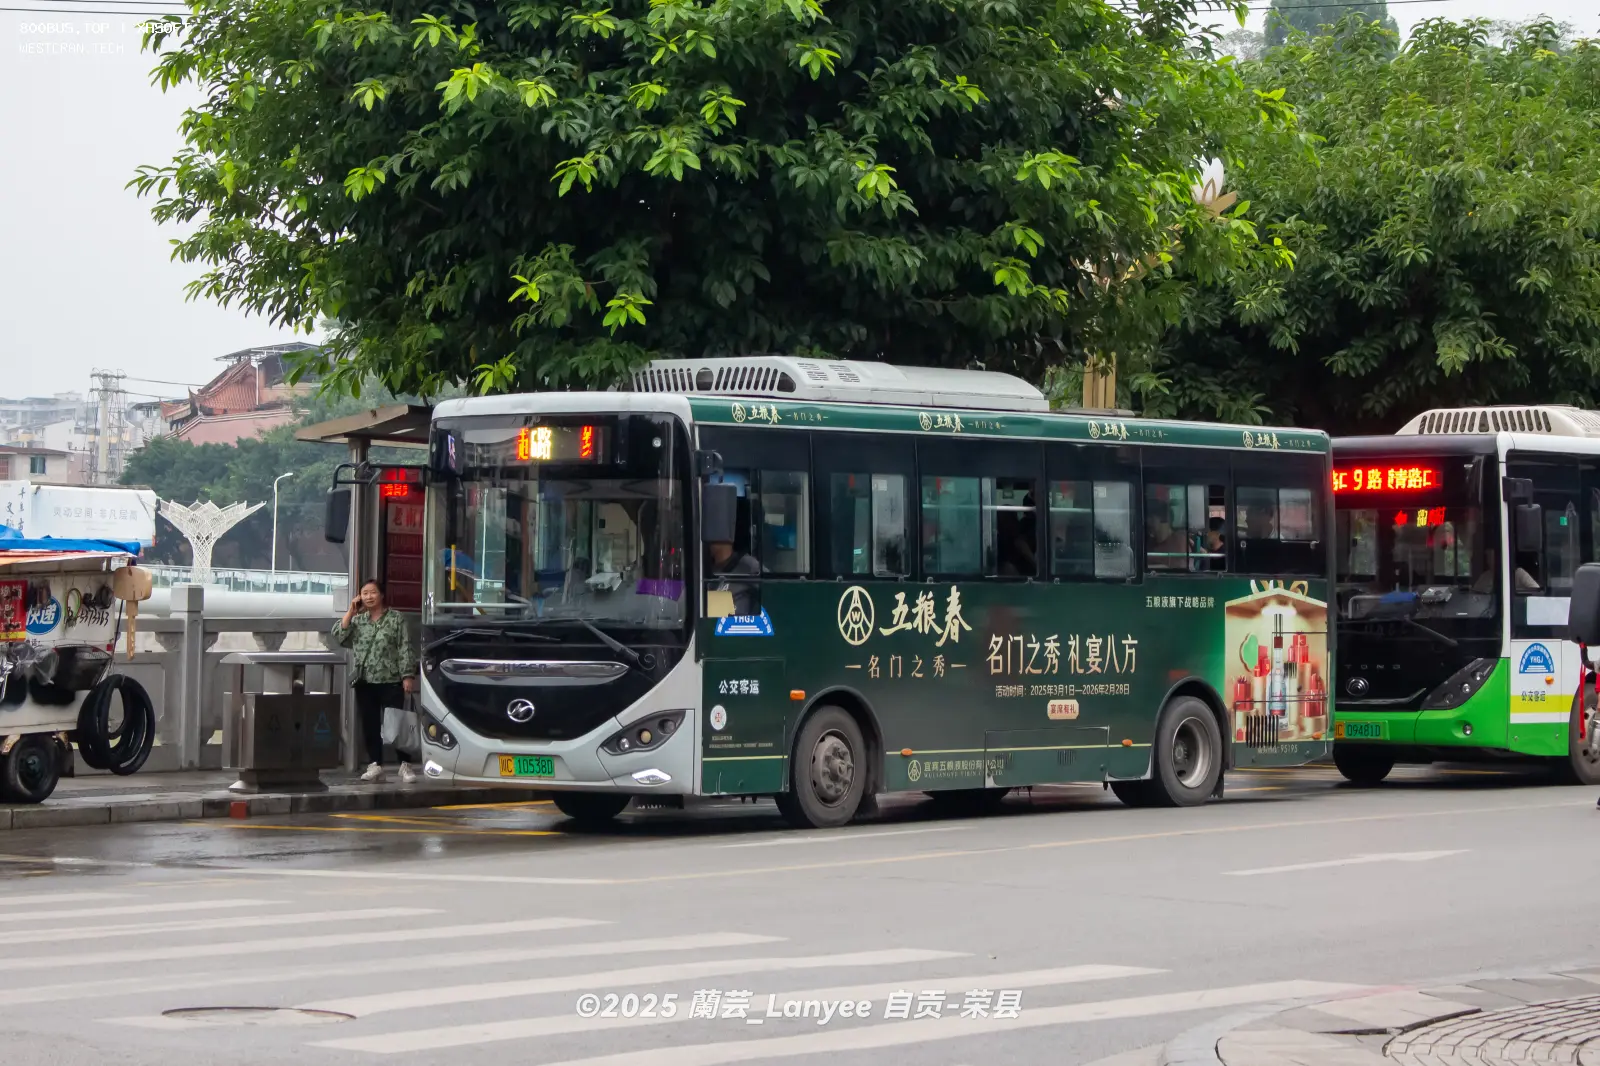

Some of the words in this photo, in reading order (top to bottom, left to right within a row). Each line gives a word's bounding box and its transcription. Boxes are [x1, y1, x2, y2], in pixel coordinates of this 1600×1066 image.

[879, 585, 973, 647] 五粮春
[1145, 596, 1215, 608] 五粮液旗下战略品牌
[986, 634, 1061, 675] 名门之秀
[1067, 634, 1138, 675] 礼宴八方
[719, 679, 760, 695] 公交客运
